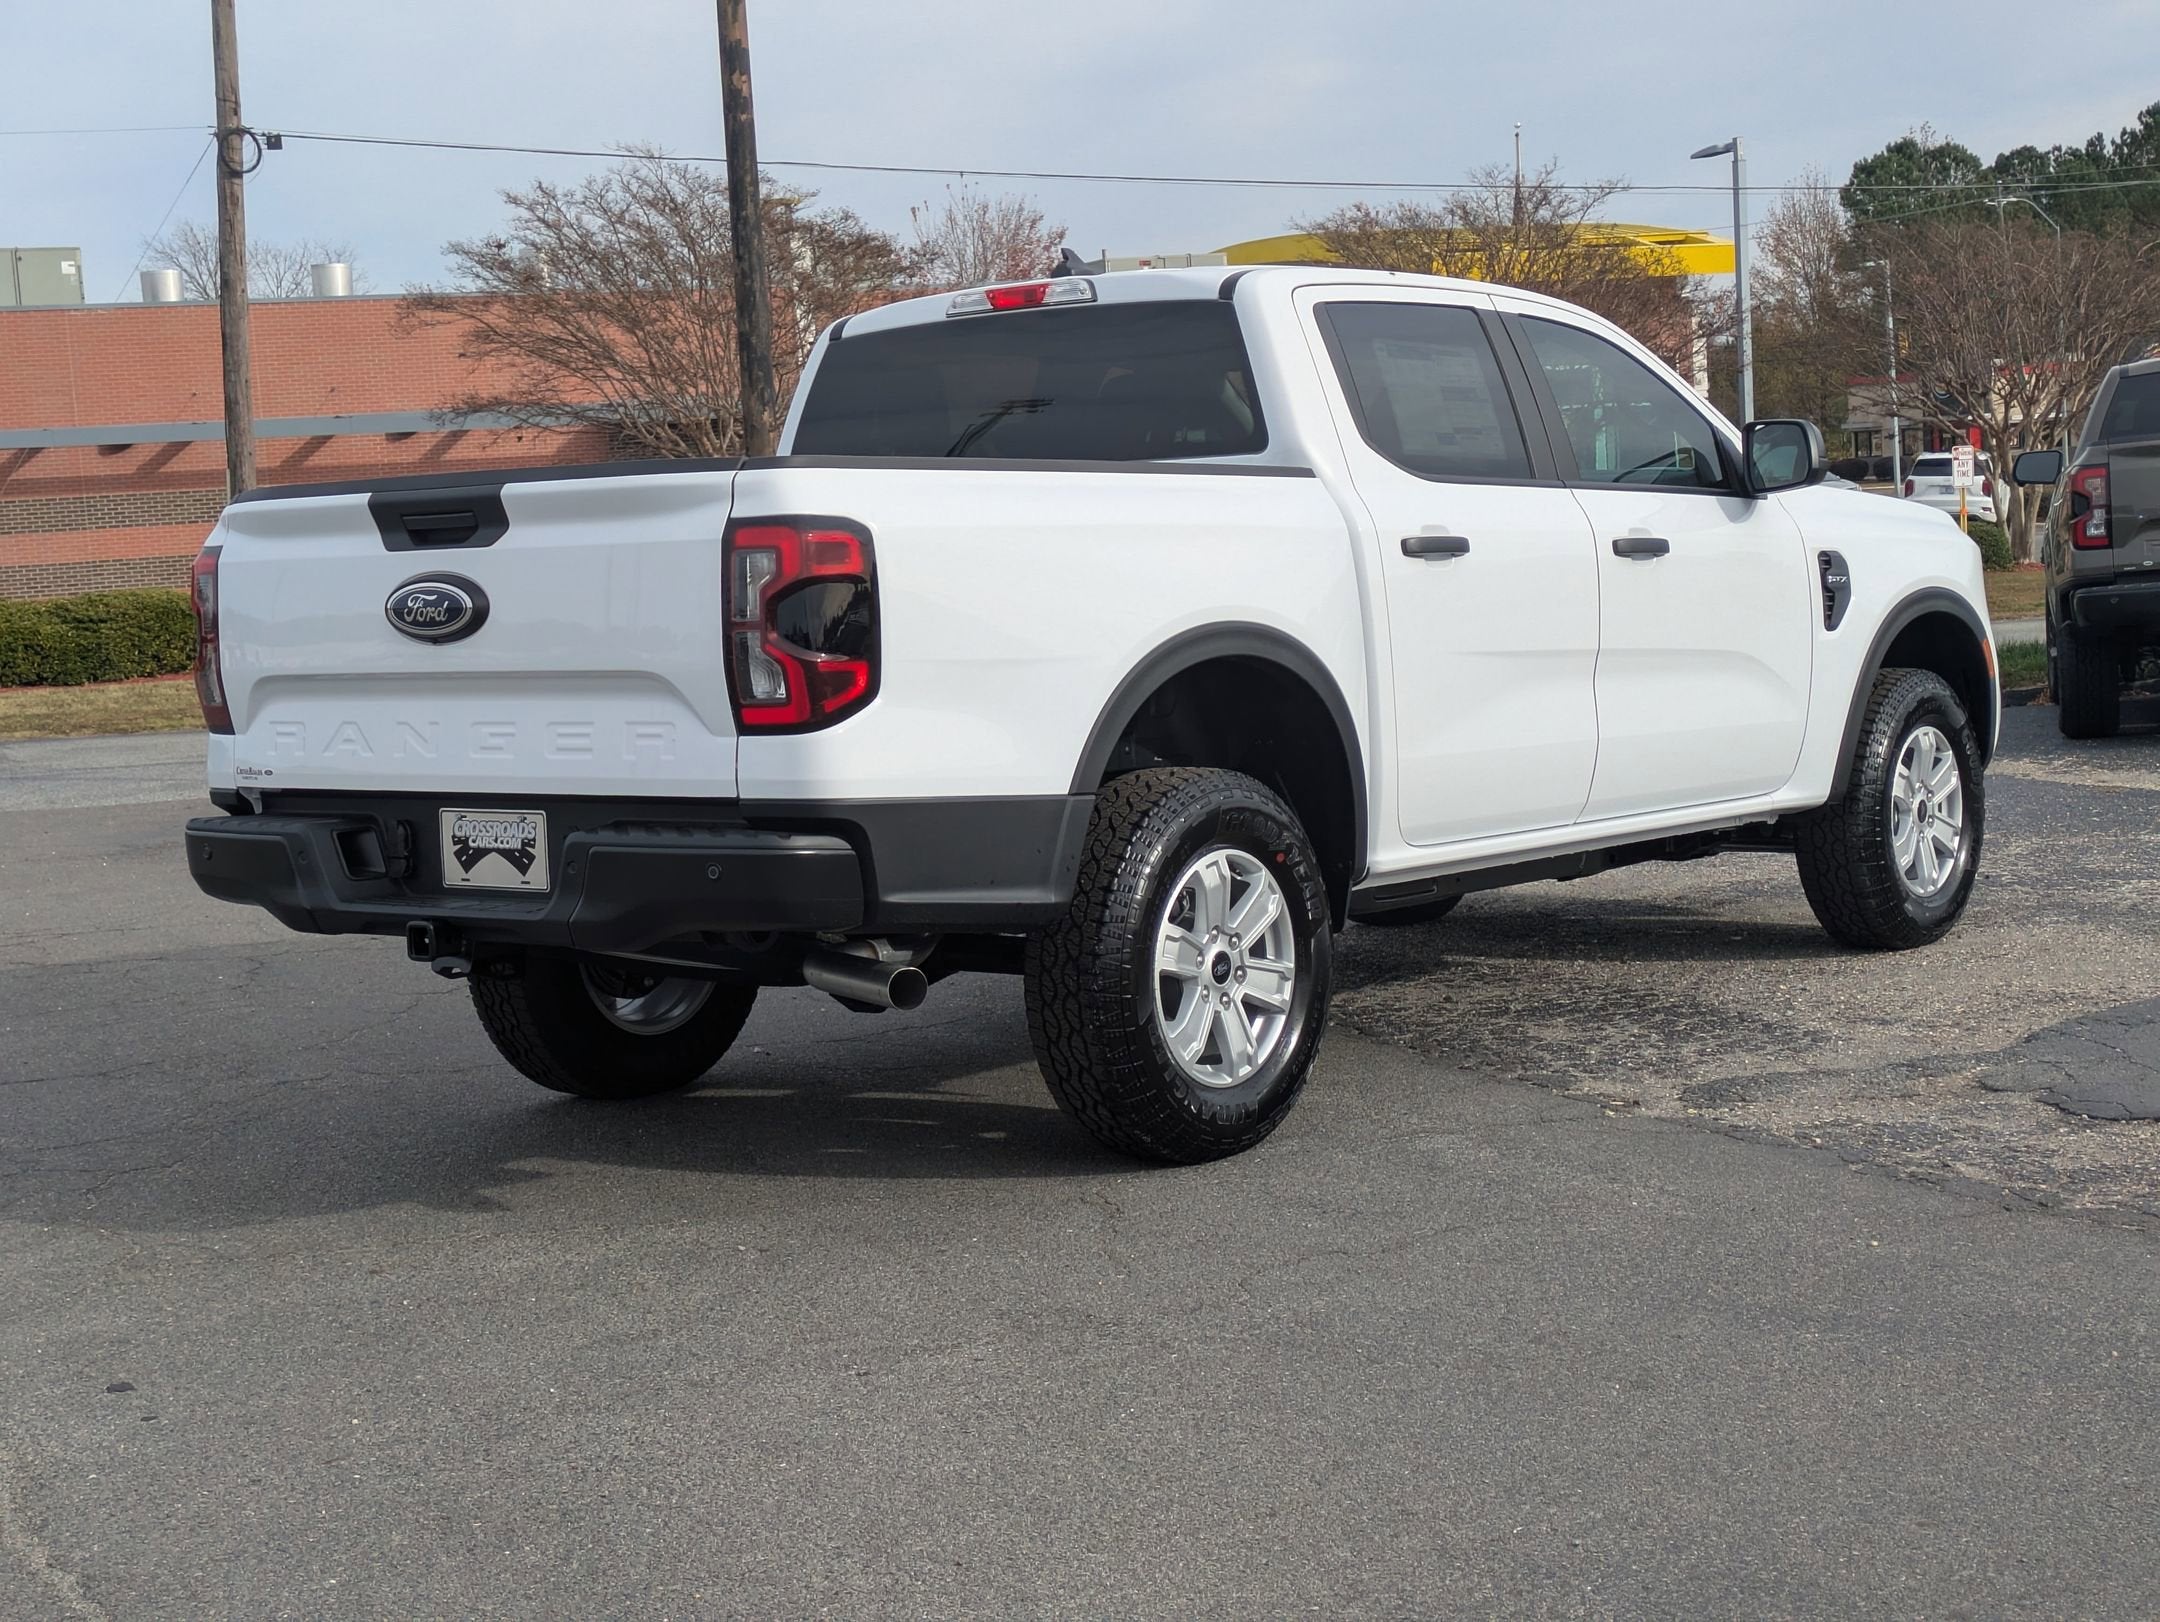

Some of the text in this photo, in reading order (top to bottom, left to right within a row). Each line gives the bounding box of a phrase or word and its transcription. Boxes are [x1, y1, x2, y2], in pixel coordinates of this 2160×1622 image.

[1957, 460, 1969, 469] ANY
[404, 594, 449, 622] Ford
[267, 721, 677, 760] RANGER
[453, 820, 536, 839] CROSSROADS
[468, 836, 522, 850] CARS.COM
